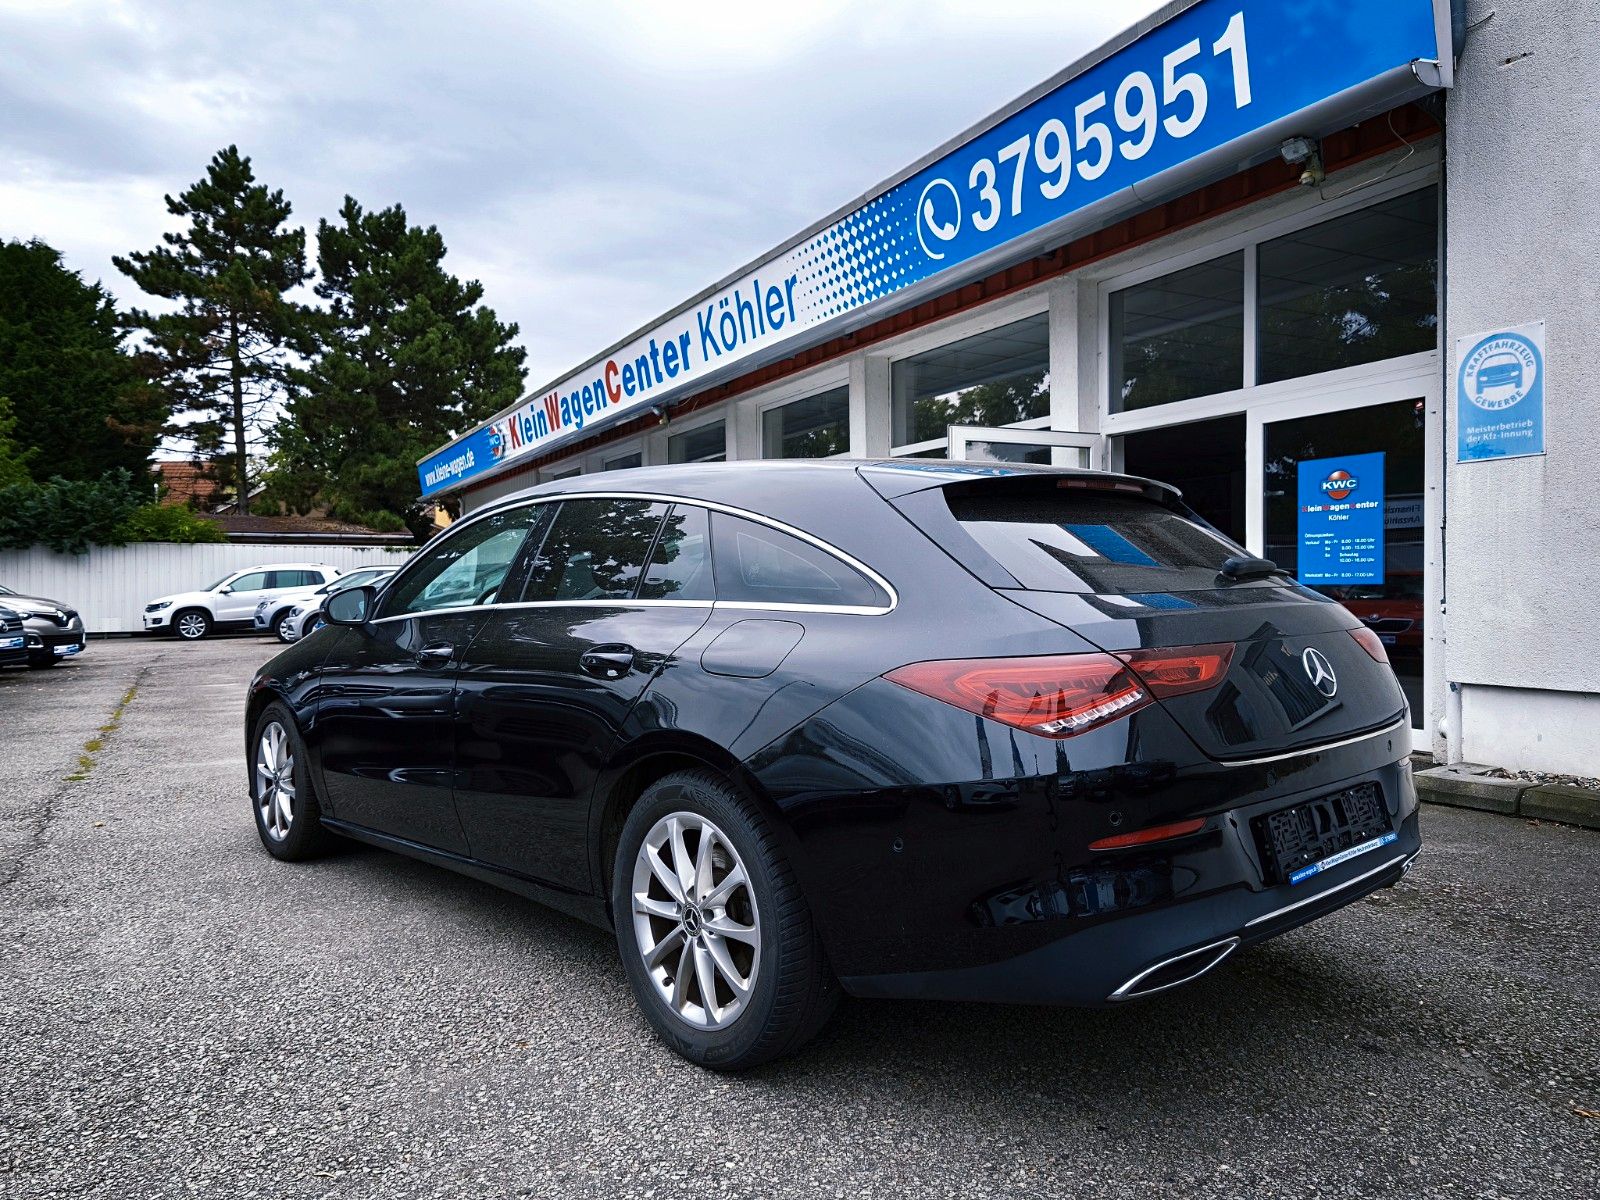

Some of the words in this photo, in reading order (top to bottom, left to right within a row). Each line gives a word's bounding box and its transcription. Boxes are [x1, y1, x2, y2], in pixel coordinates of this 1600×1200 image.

[968, 11, 1252, 232] 3795951
[508, 331, 691, 449] KleinWagenCenter
[698, 274, 797, 361] Köhler
[1466, 340, 1535, 377] KRAFTFAHRZEUG
[1475, 389, 1524, 408] GEWERBE
[1466, 419, 1533, 434] Meisterbetrieb
[1466, 434, 1481, 443] der
[1322, 479, 1357, 490] KWC
